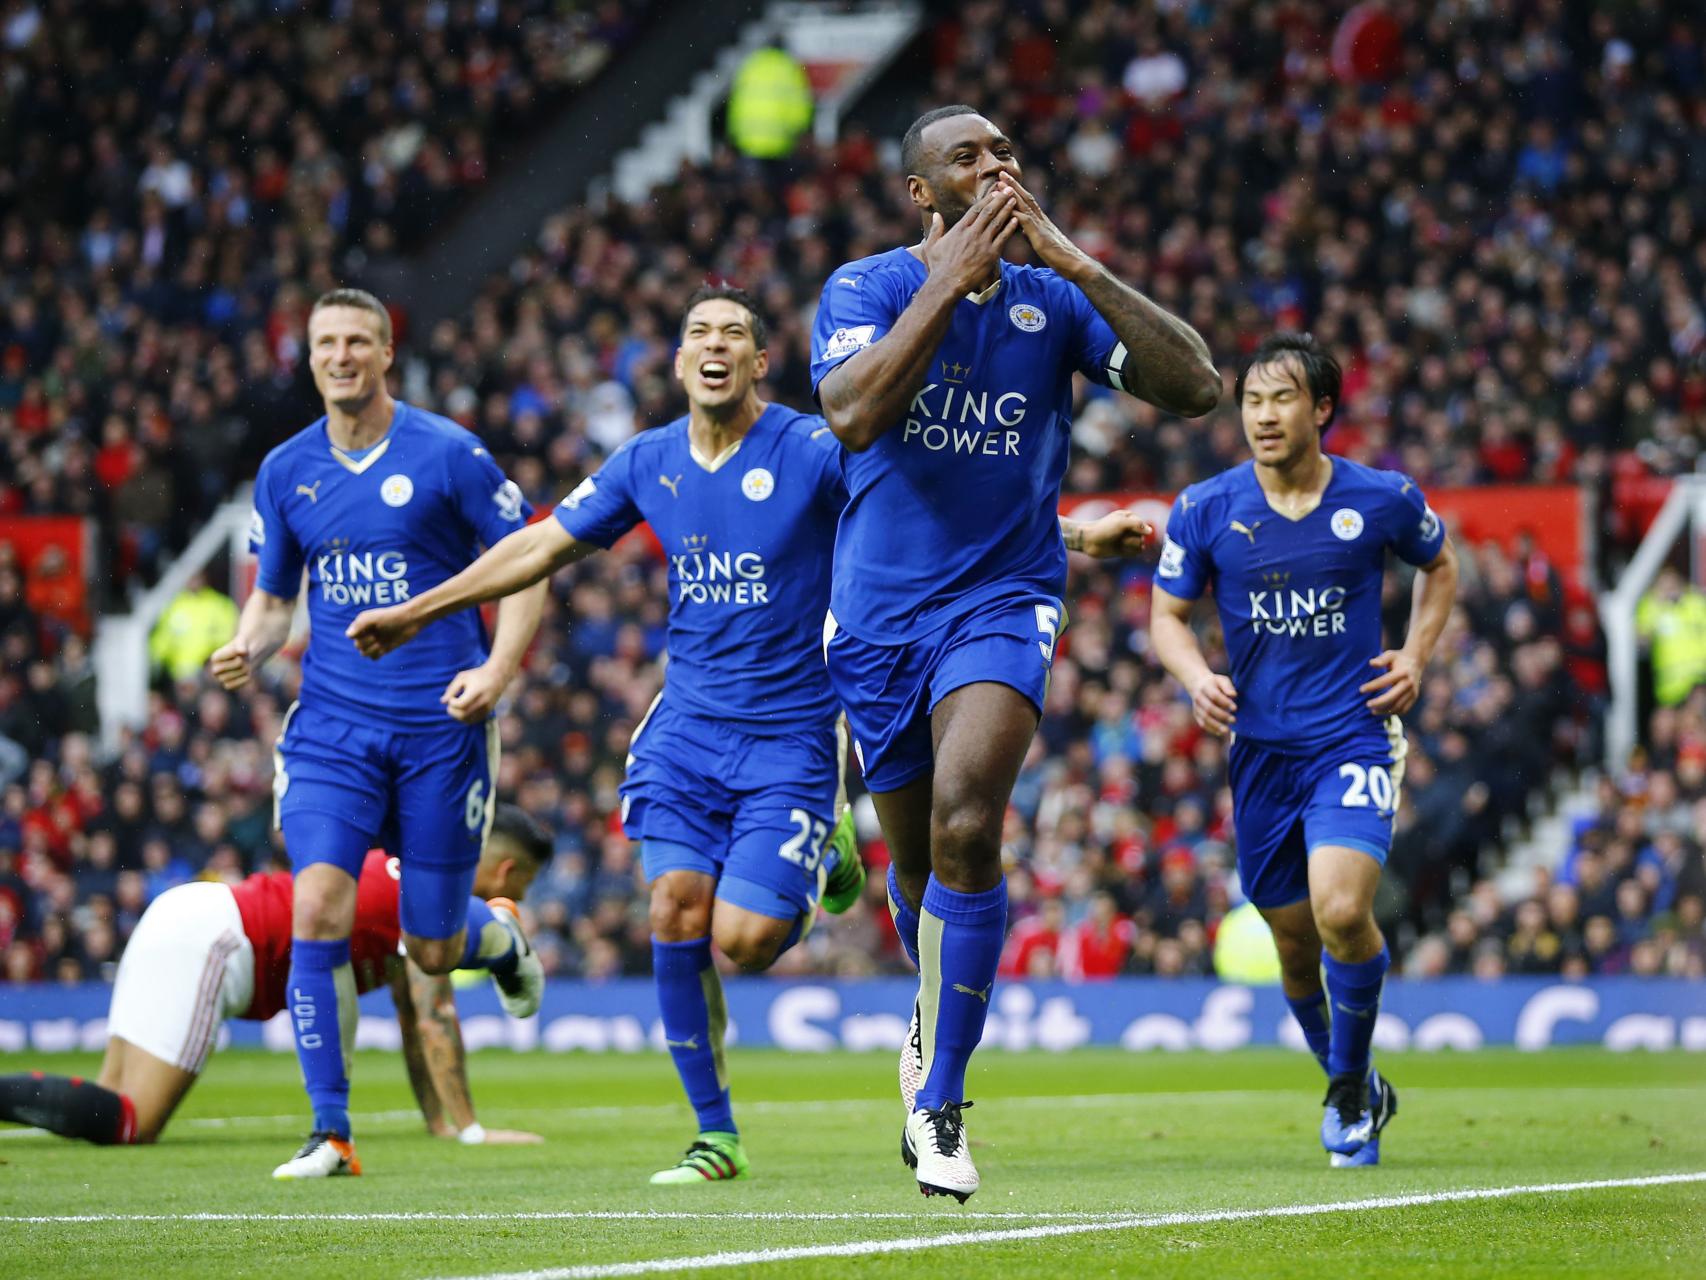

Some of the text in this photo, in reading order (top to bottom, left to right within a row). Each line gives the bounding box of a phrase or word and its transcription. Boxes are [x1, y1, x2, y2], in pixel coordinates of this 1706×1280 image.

[910, 383, 1027, 427] KING
[903, 418, 1021, 456] POWER
[318, 551, 408, 583] KING
[671, 551, 765, 581] KING
[322, 579, 410, 605] POWER
[679, 581, 769, 604] POWER
[1248, 586, 1347, 620] KING
[1034, 604, 1058, 661] 5
[466, 778, 484, 830] 6
[1339, 762, 1392, 811] 20
[778, 808, 827, 872] 23
